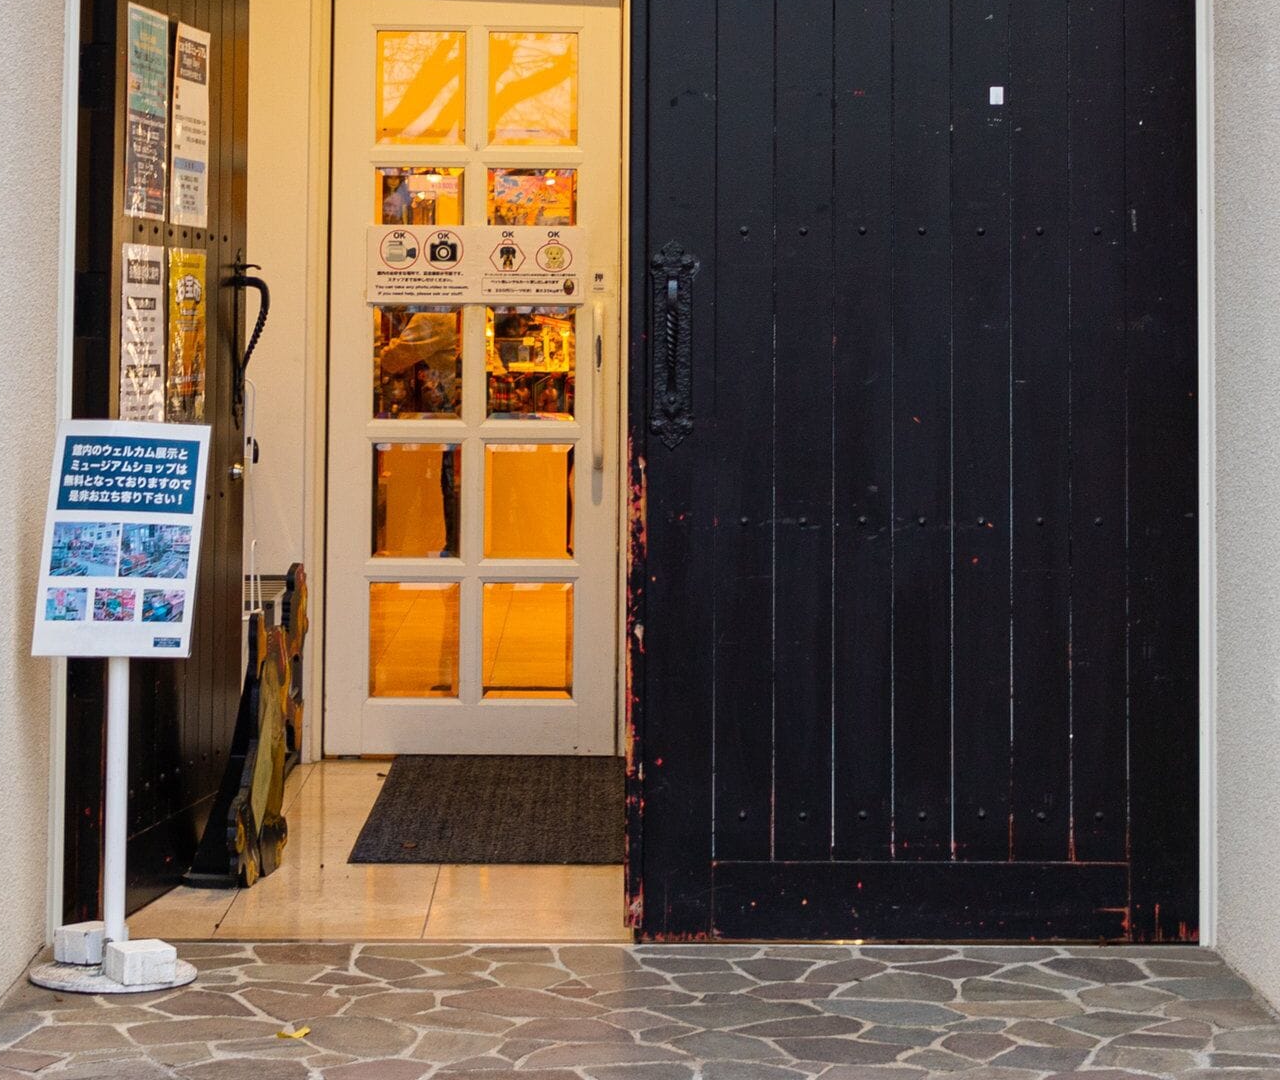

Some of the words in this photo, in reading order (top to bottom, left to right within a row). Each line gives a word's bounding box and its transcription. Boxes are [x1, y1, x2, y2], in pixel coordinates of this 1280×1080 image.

[437, 232, 450, 240] OK
[72, 444, 188, 460] 館内のウェルカム展示と
[70, 460, 188, 475] ミュージアムショップは
[63, 474, 192, 490] 無料となっておりますので
